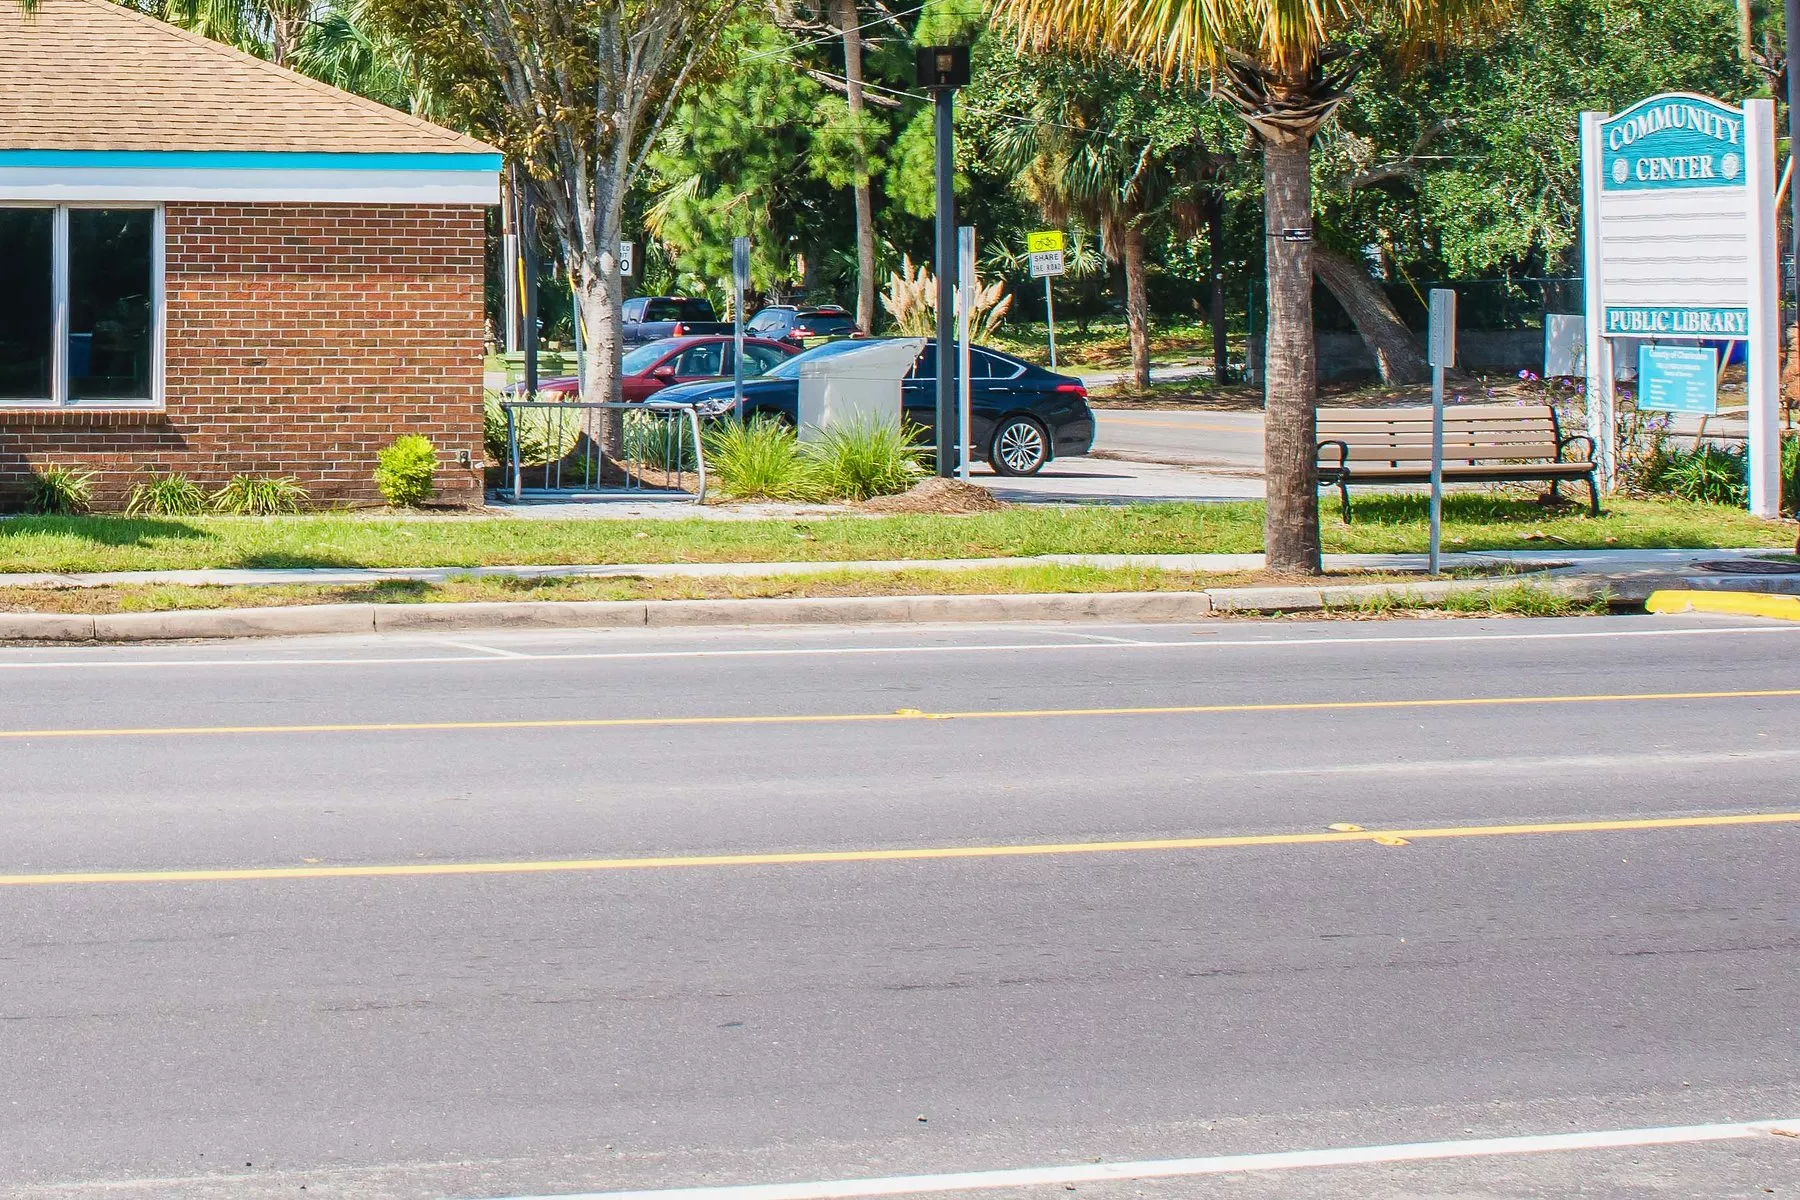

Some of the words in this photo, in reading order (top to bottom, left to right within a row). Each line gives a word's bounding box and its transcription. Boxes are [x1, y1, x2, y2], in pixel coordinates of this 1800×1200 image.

[1609, 104, 1740, 151] COMMUNITY
[1636, 155, 1715, 181] CENTER
[1033, 264, 1044, 272] THE
[1046, 263, 1061, 271] ROAD
[1610, 310, 1669, 331] PUBLIC
[1673, 311, 1746, 332] LIBRARY
